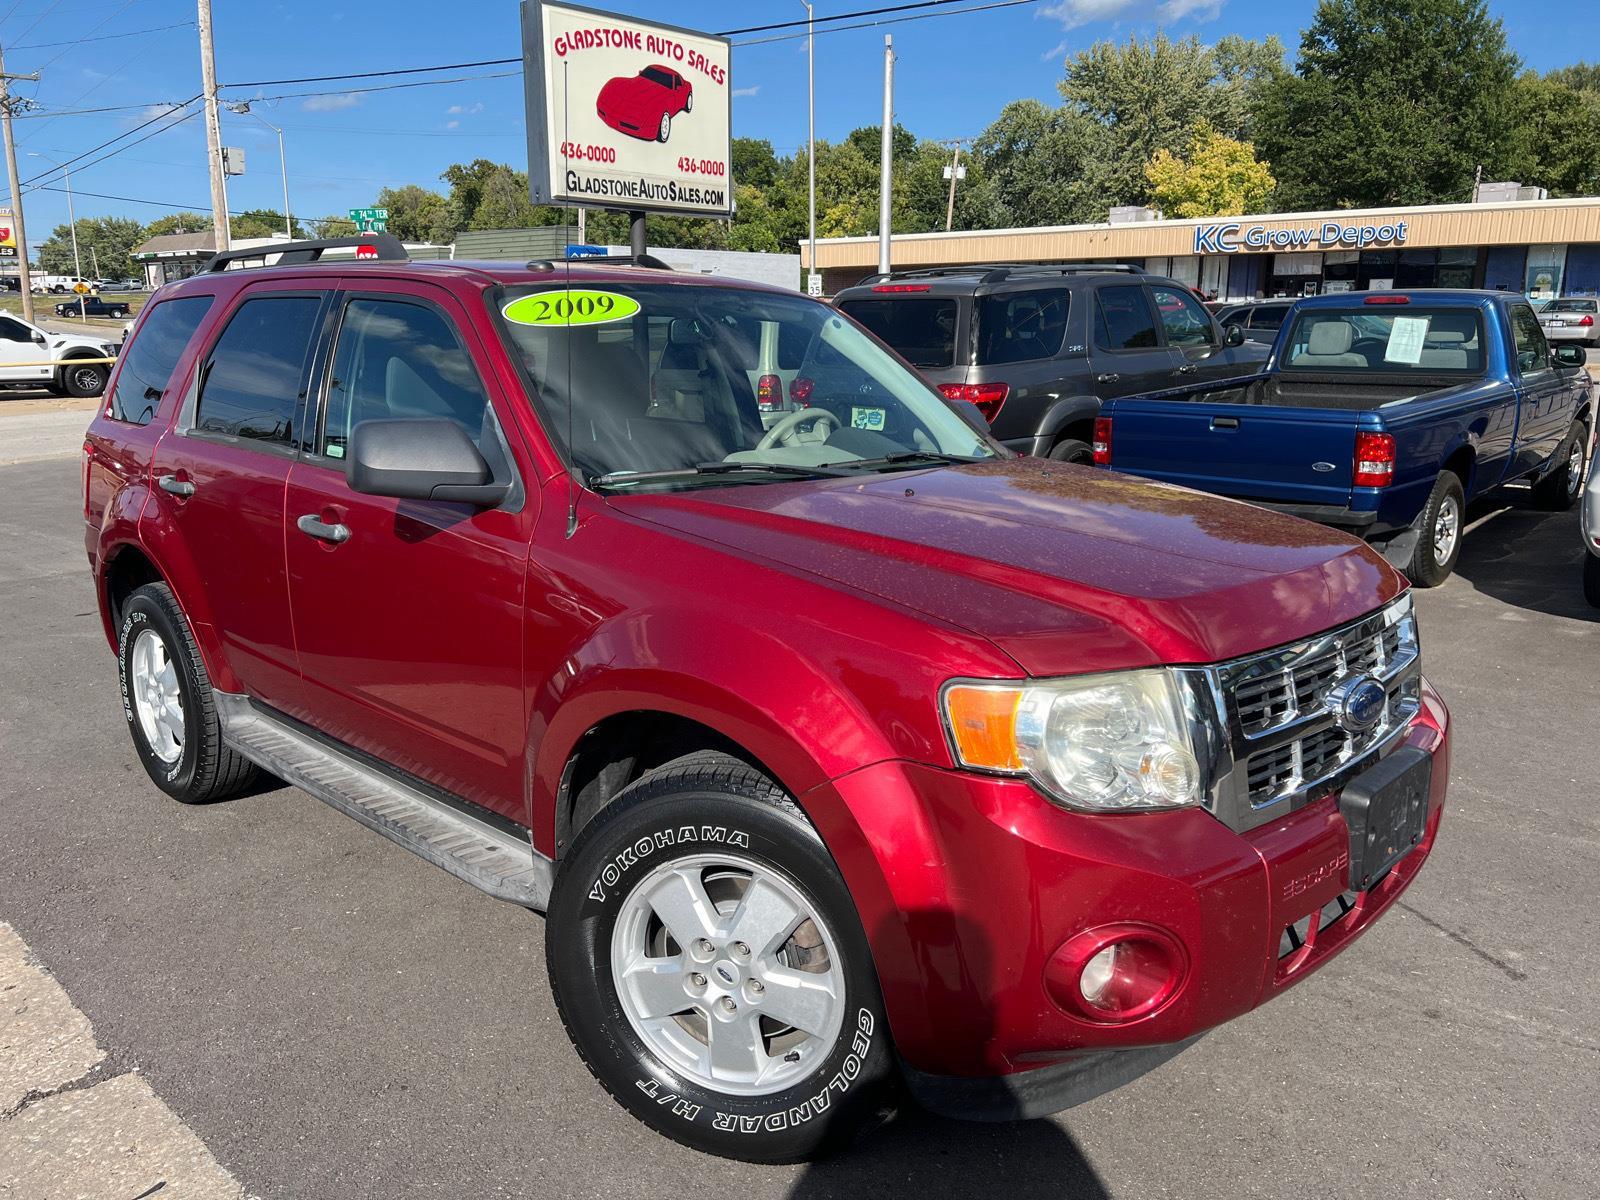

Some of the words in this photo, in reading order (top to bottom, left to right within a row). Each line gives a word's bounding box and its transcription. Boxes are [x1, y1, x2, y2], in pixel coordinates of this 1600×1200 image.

[554, 28, 642, 57] GLADSTONE
[646, 34, 684, 61] AUTO
[687, 50, 726, 85] SALES
[560, 142, 616, 163] 436-0000
[677, 156, 725, 176] 436-0000
[375, 209, 388, 219] TER
[1193, 223, 1241, 254] KC
[1245, 225, 1315, 247] Grow
[1320, 220, 1408, 247] Depot
[532, 293, 615, 322] 2009
[810, 286, 821, 295] 35
[588, 825, 750, 903] YOKOHAMA
[1282, 851, 1348, 901] ESCAPE
[711, 1006, 875, 1134] GEOLANDAR
[635, 1076, 702, 1122] H/T
